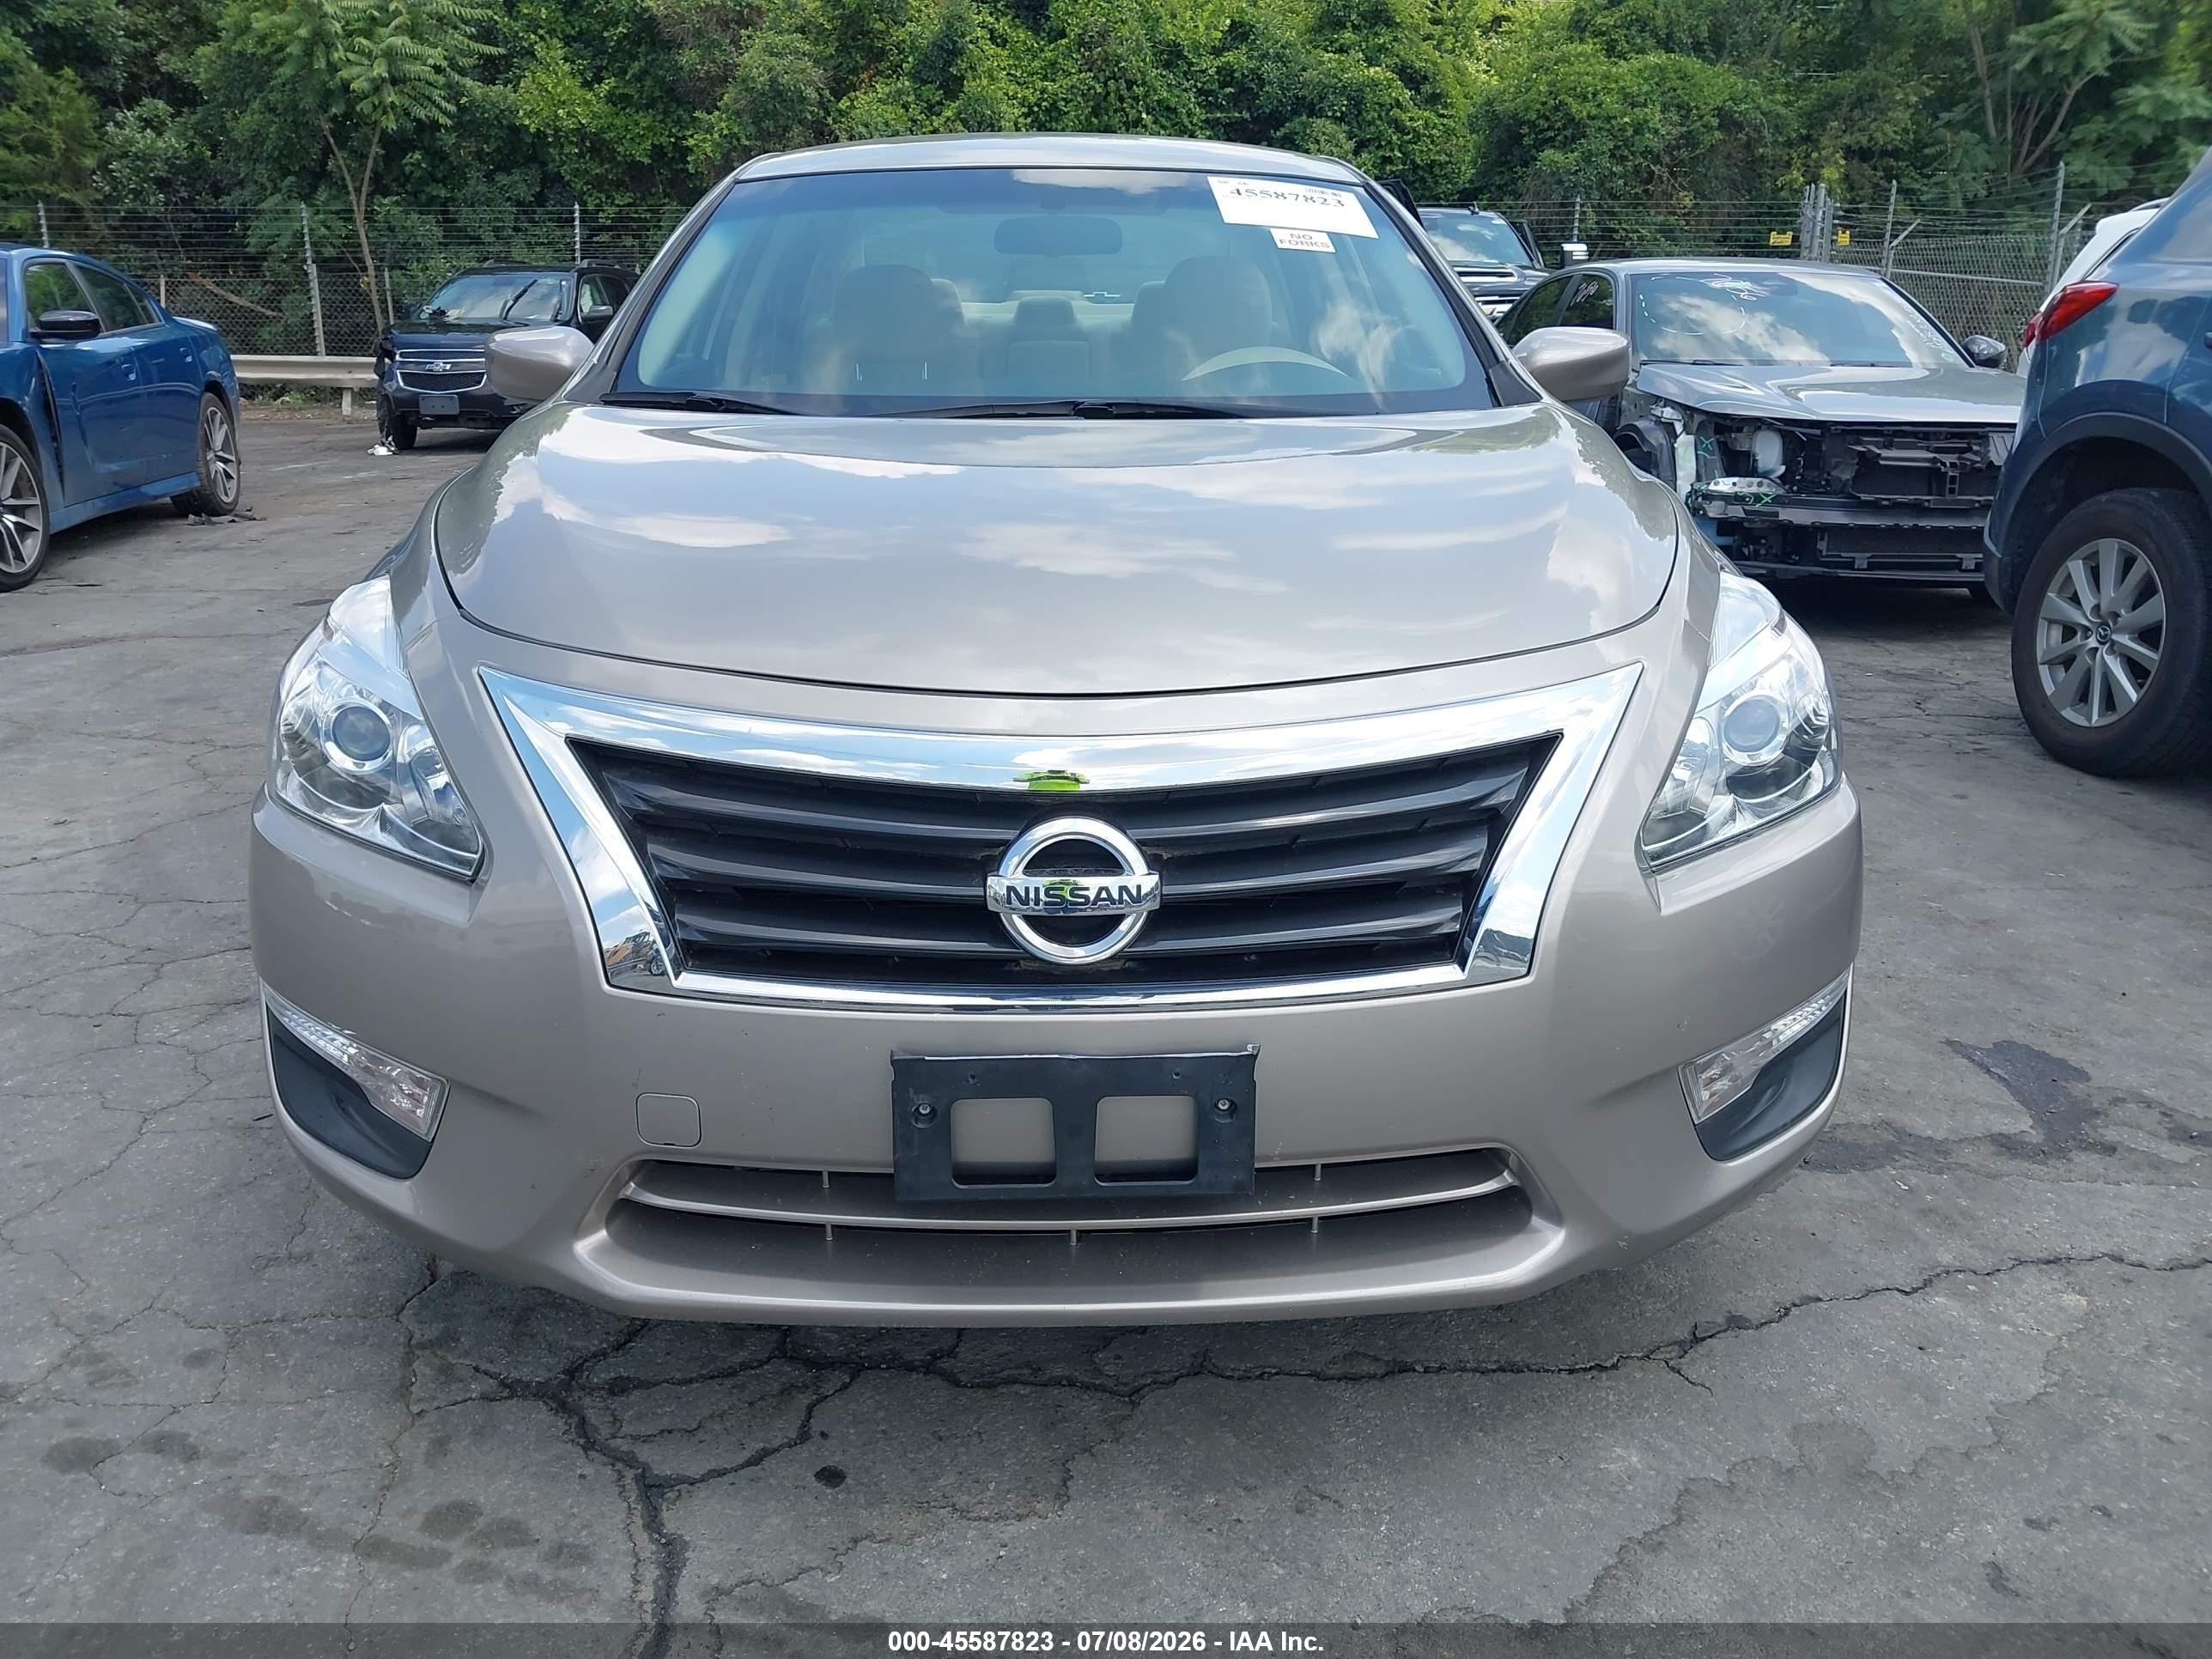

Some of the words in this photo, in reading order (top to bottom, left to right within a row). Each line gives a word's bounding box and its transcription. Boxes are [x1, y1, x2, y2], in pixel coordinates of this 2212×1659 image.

[1229, 187, 1346, 208] 45587823
[1279, 239, 1331, 249] FORKS
[1005, 884, 1143, 908] NISSAN
